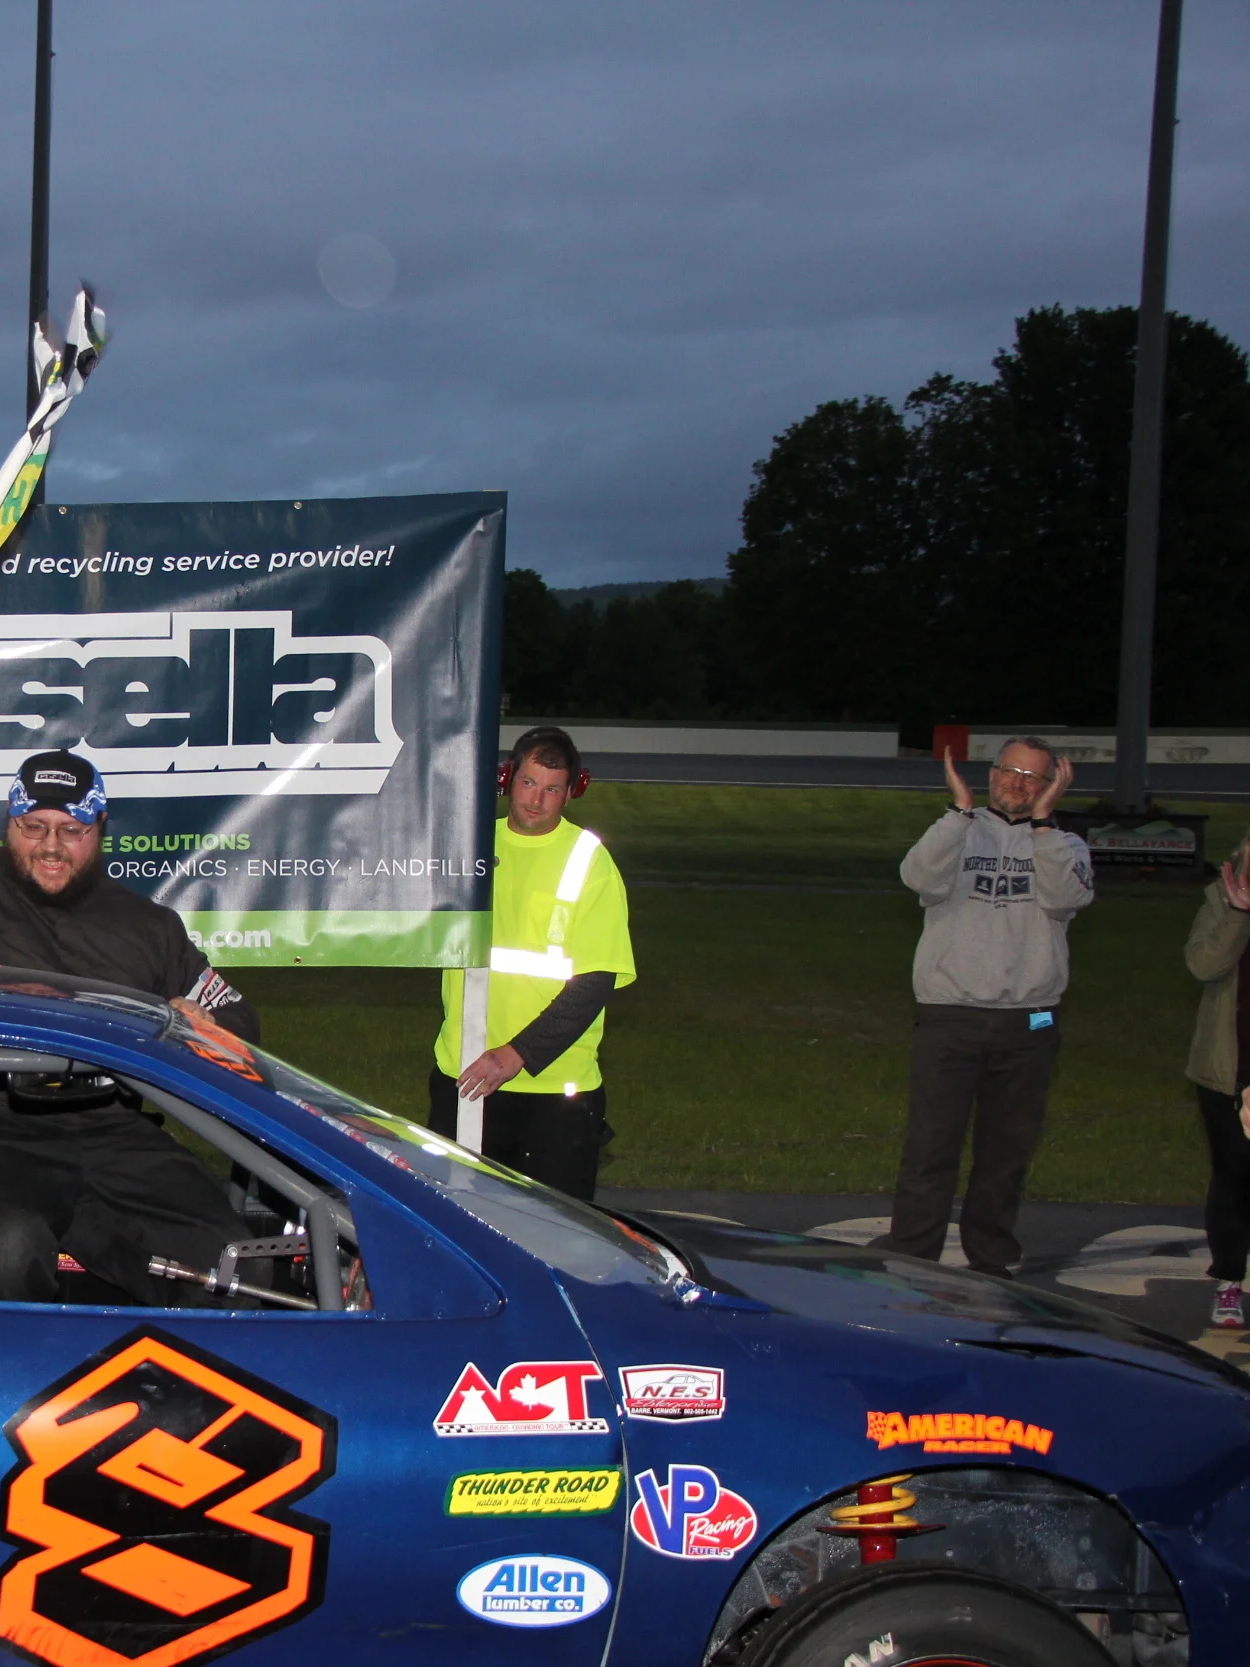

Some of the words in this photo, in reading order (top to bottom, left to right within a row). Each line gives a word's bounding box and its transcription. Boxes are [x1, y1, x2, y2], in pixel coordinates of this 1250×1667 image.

[27, 551, 154, 578] recycling
[161, 550, 261, 572] service
[268, 544, 396, 573] provider!
[119, 832, 251, 854] SOLUTIONS
[107, 859, 228, 880] ORGANICS
[246, 858, 341, 878] ENERGY
[360, 857, 487, 877] LANDFILLS
[437, 1362, 601, 1423] ACT
[641, 1385, 712, 1398] N.E.S
[877, 1411, 1054, 1456] AMERICAN
[458, 1477, 550, 1496] THUNDER
[553, 1475, 610, 1493] ROAD
[634, 1463, 721, 1557] VP
[689, 1513, 754, 1545] Racing
[689, 1546, 731, 1557] FUELS
[483, 1563, 585, 1593] Allen
[485, 1595, 550, 1611] lumber
[554, 1599, 580, 1611] co.
